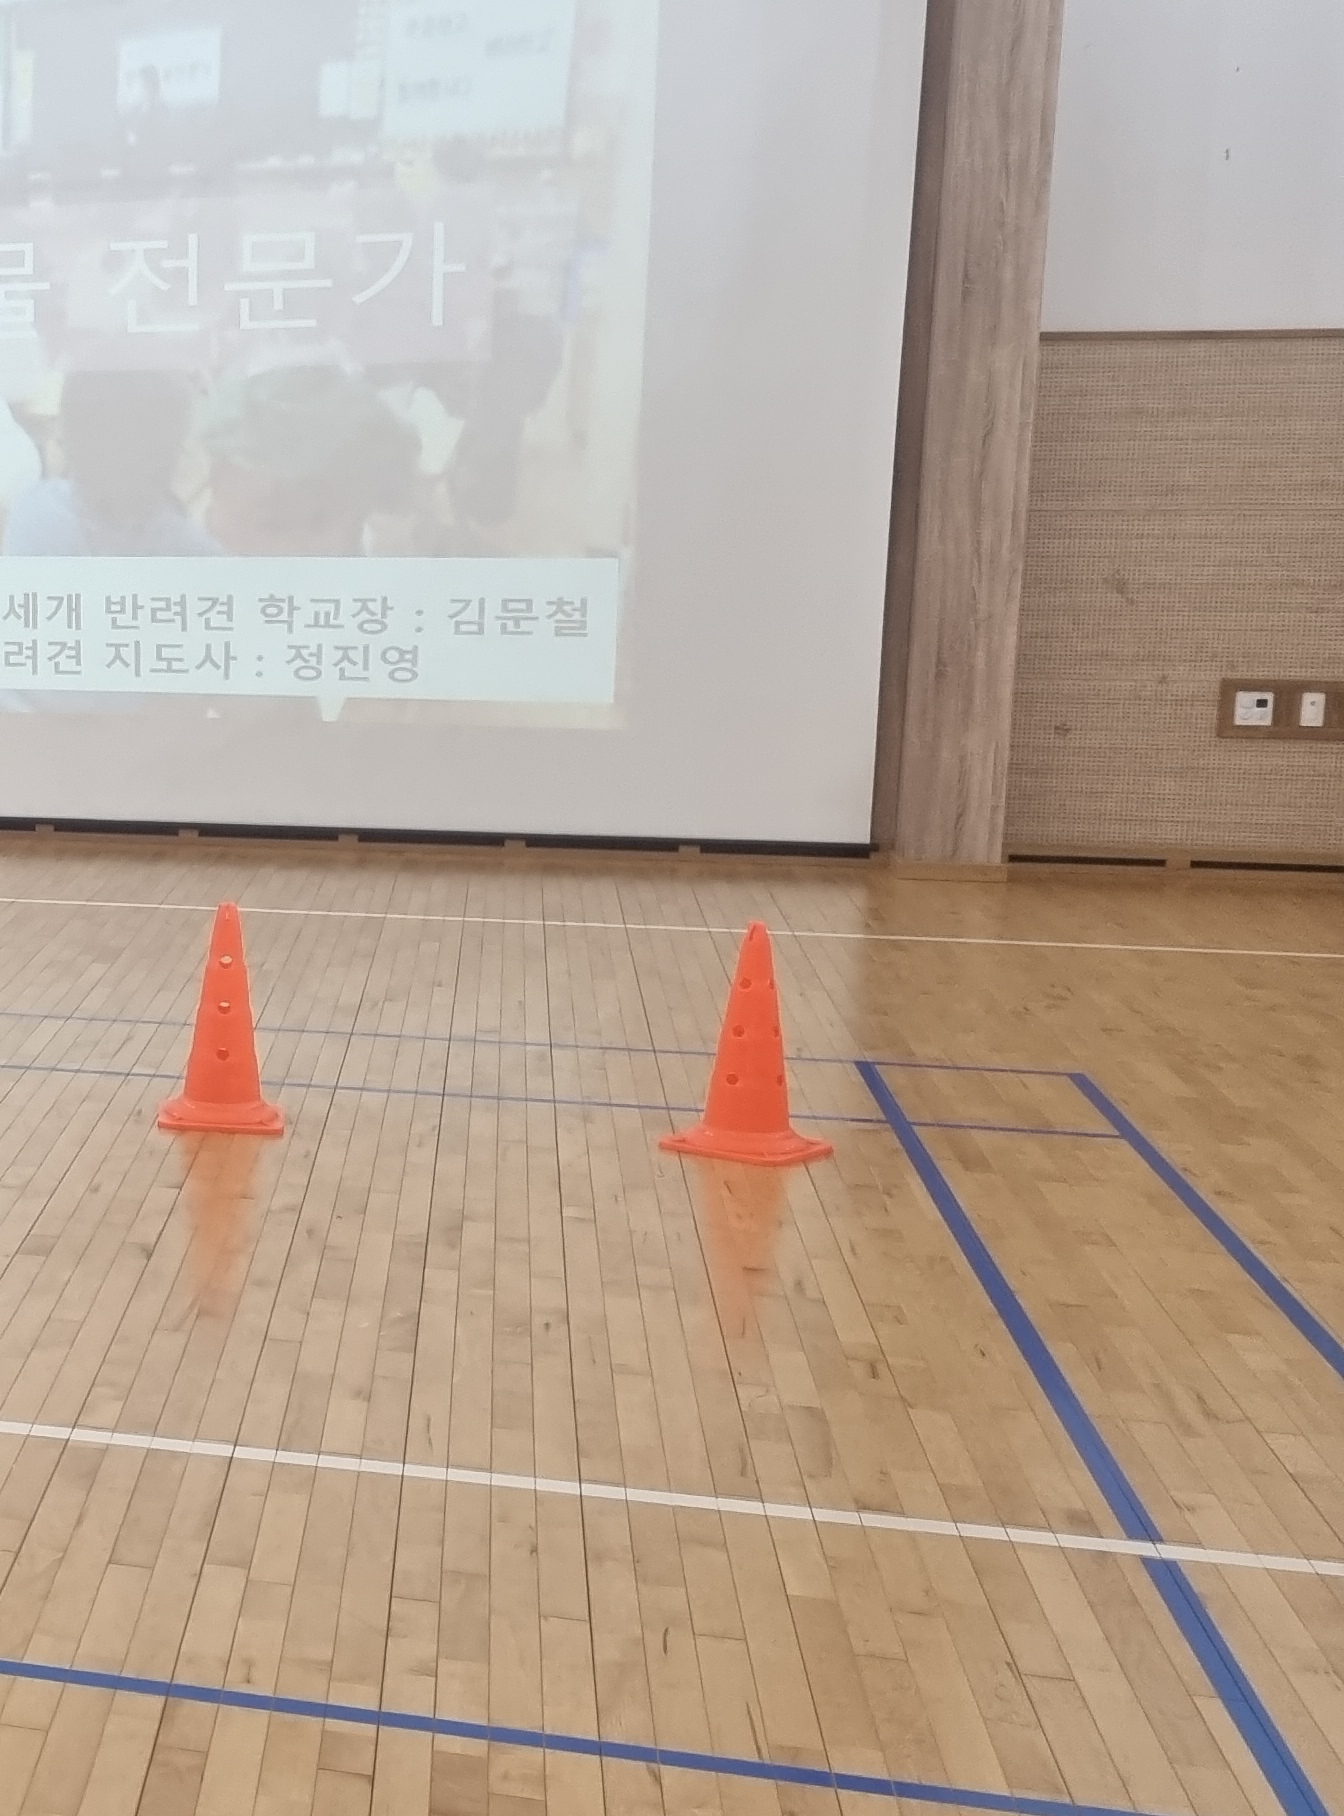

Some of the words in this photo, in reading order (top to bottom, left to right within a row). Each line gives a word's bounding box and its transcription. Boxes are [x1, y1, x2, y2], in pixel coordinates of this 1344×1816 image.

[107, 221, 467, 335] 전문가
[104, 593, 236, 633] 반려견
[258, 593, 394, 636] 학교장
[447, 594, 590, 638] 김문철
[104, 640, 236, 681] 지도사
[285, 642, 421, 684] 정진영
